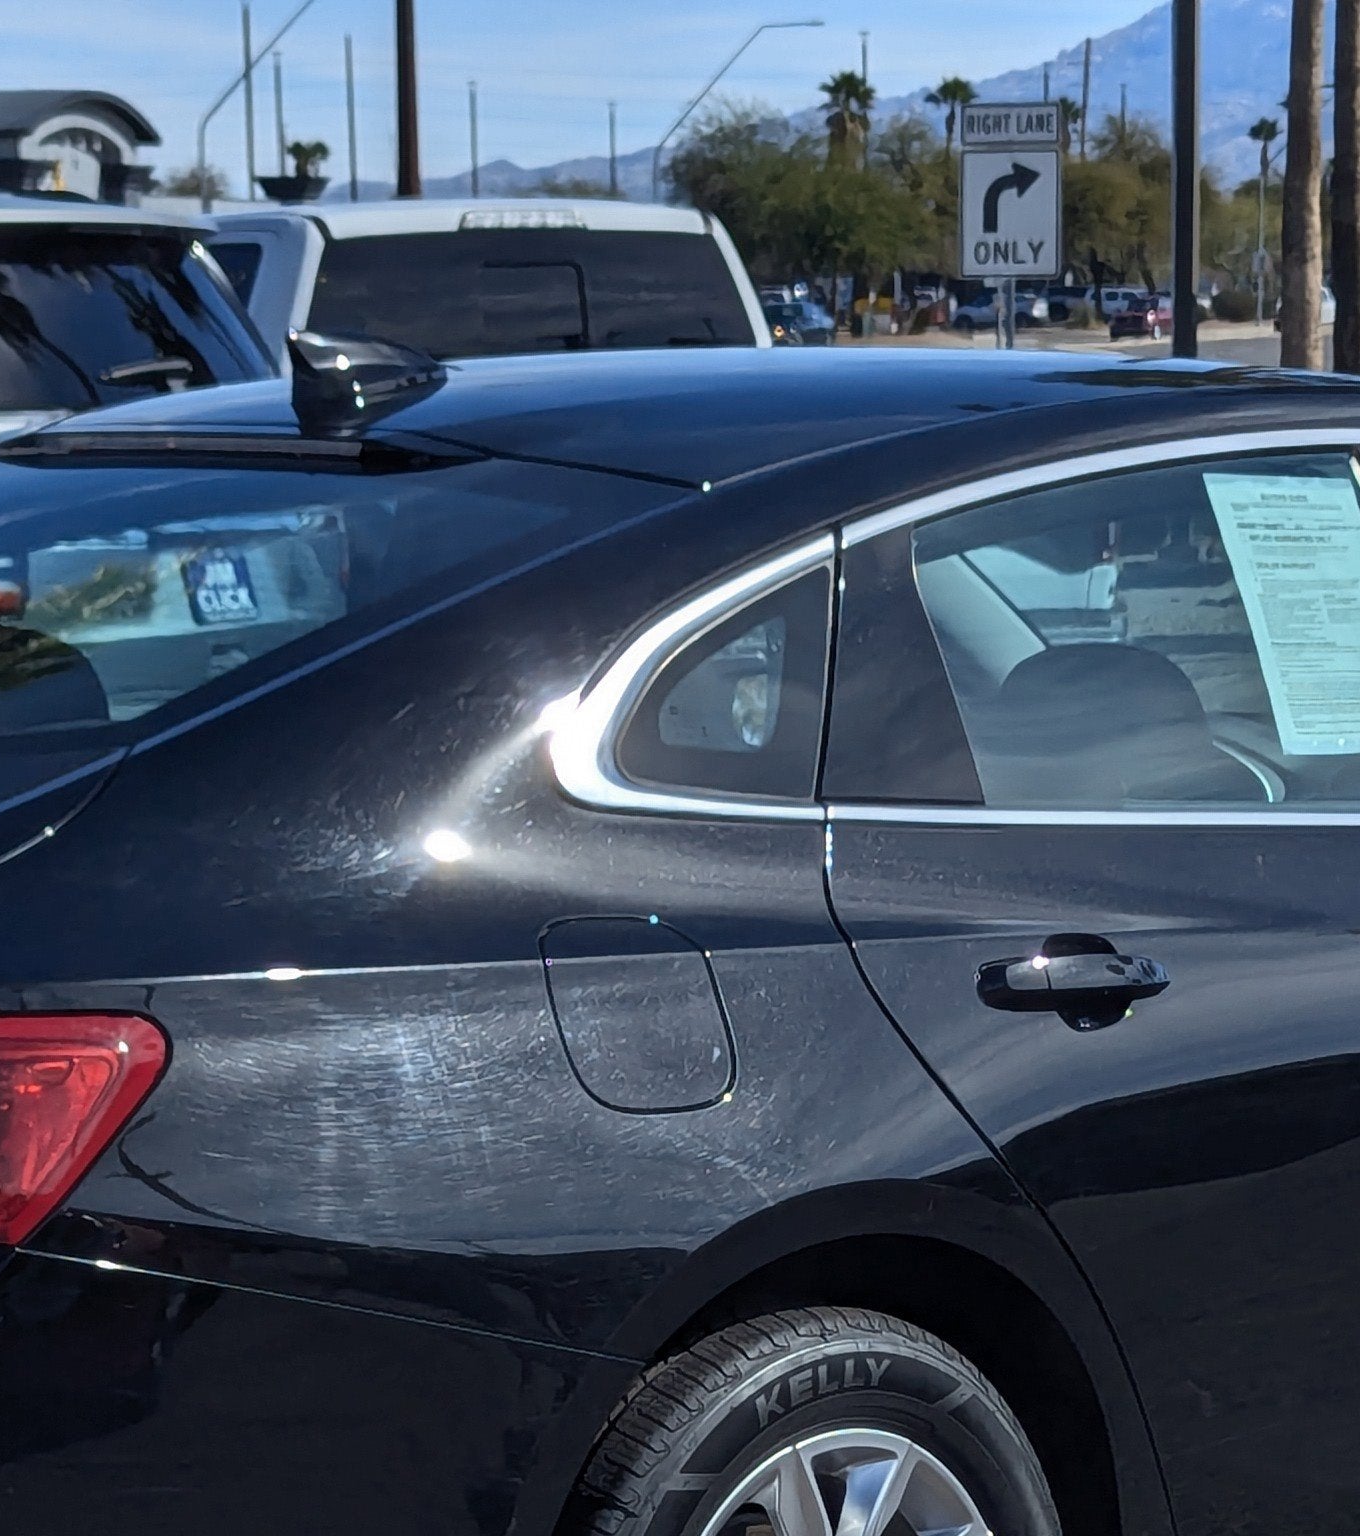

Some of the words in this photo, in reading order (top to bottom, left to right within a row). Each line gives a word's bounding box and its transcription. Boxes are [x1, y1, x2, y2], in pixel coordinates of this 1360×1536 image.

[966, 113, 1011, 135] RIGHT
[1016, 113, 1054, 134] LANE
[974, 240, 1044, 265] ONLY
[754, 1357, 892, 1430] KELLY
